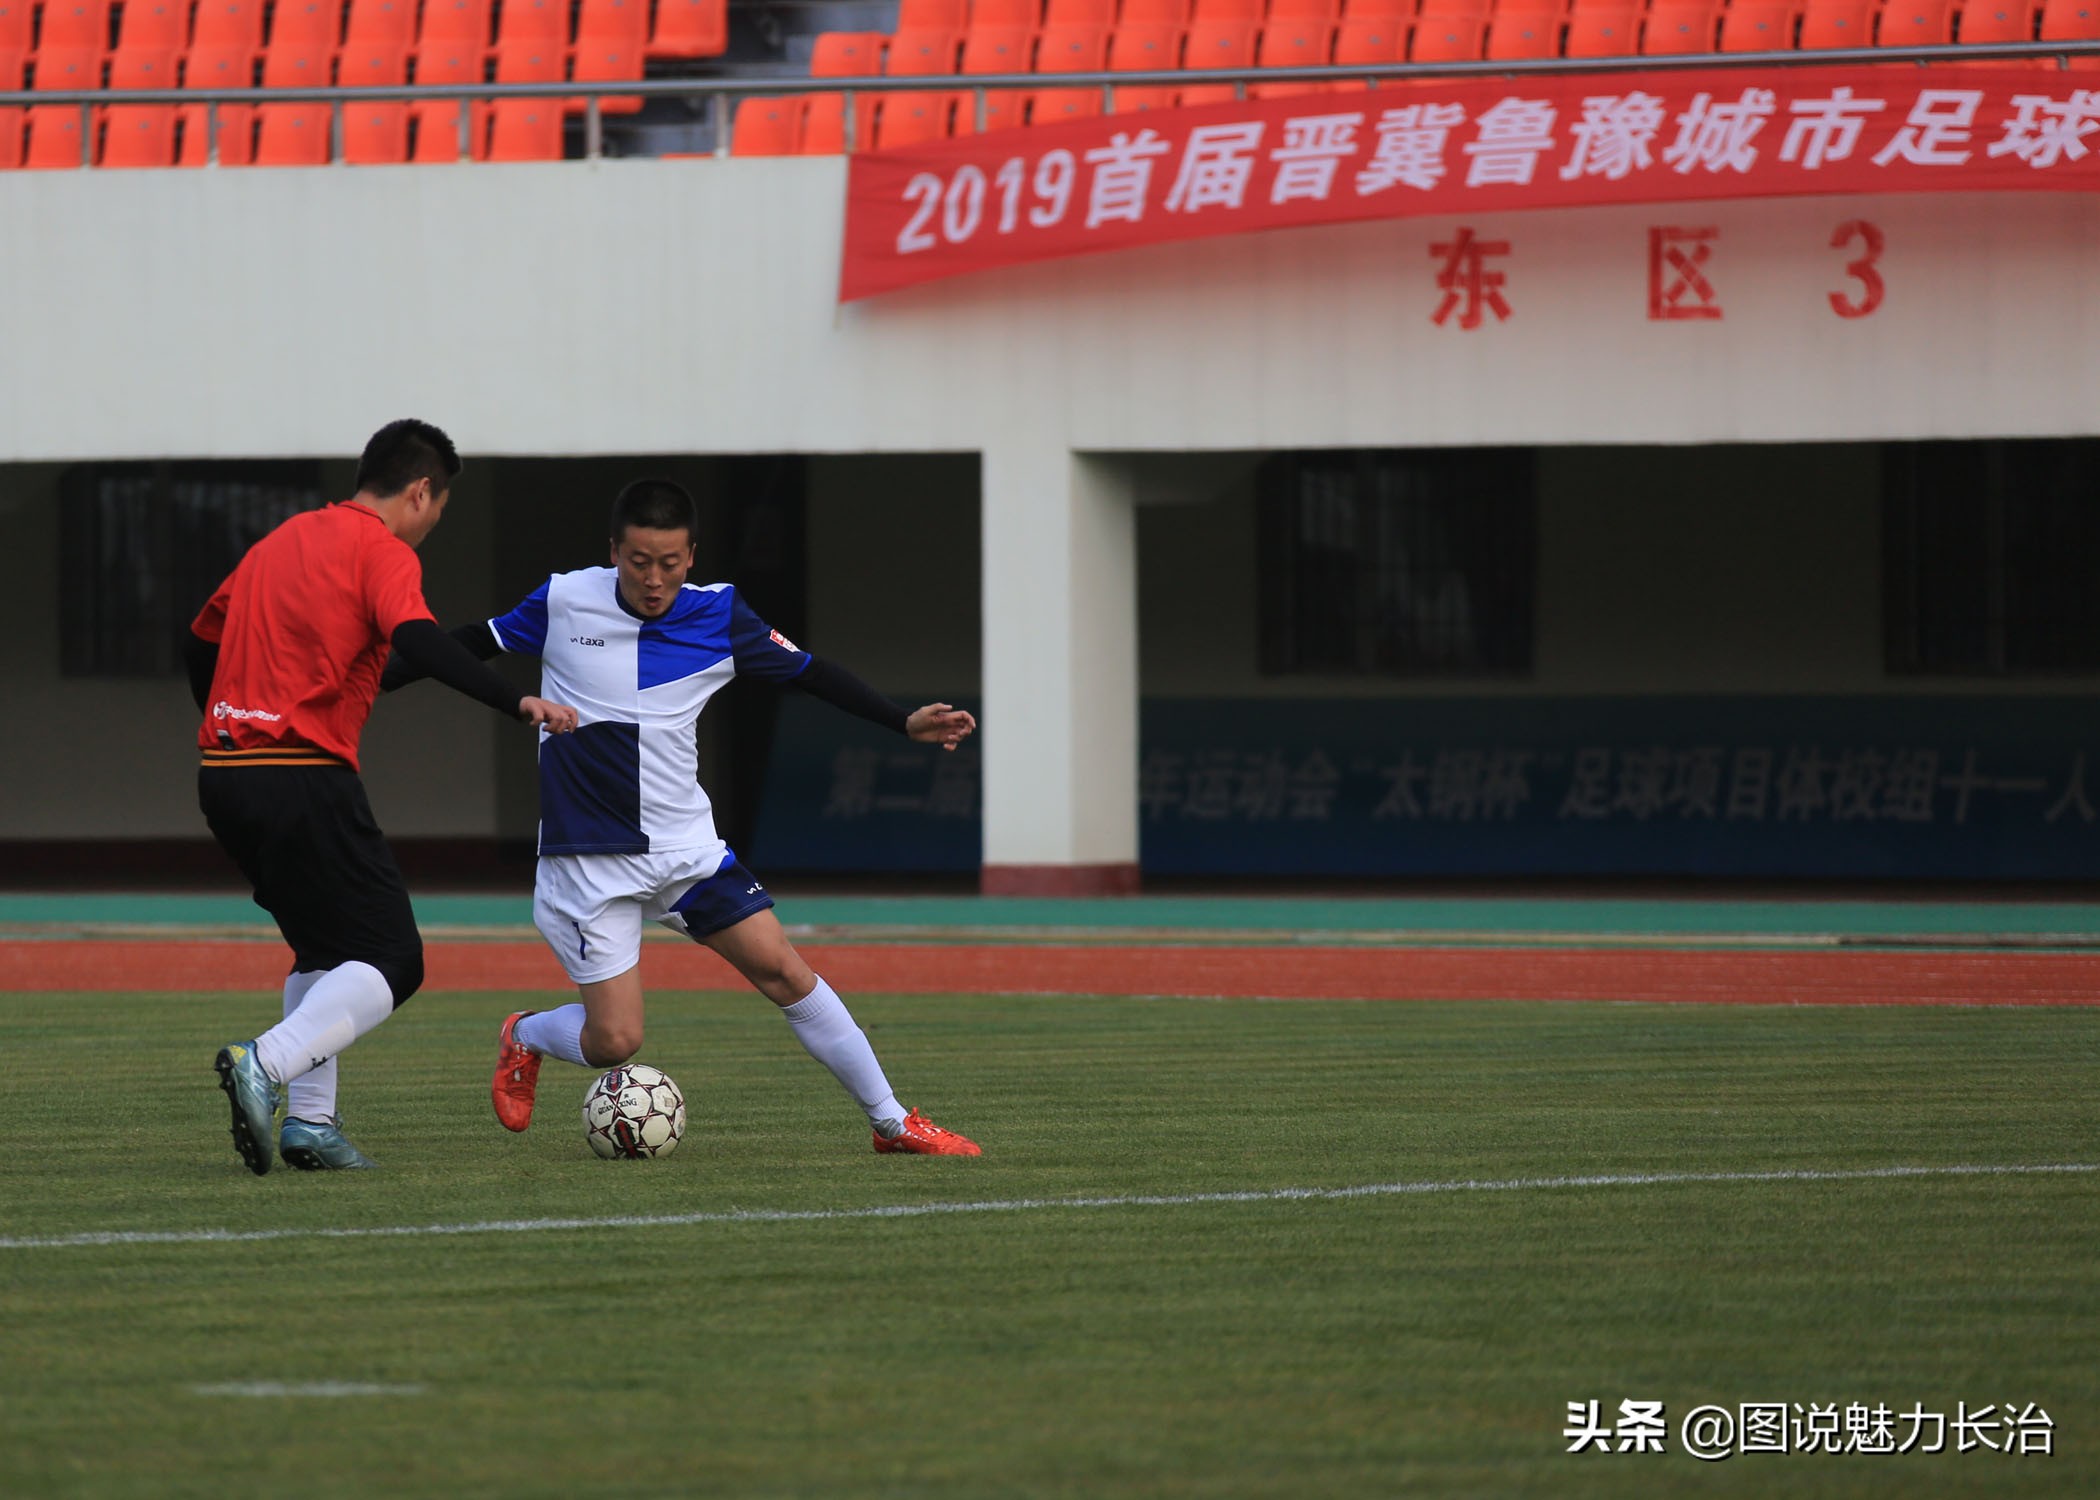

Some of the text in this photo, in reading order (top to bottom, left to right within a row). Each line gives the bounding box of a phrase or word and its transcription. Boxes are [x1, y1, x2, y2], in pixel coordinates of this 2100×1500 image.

[896, 85, 2100, 254] 2019首届晋冀鲁豫城市足球
[580, 636, 605, 648] taxa
